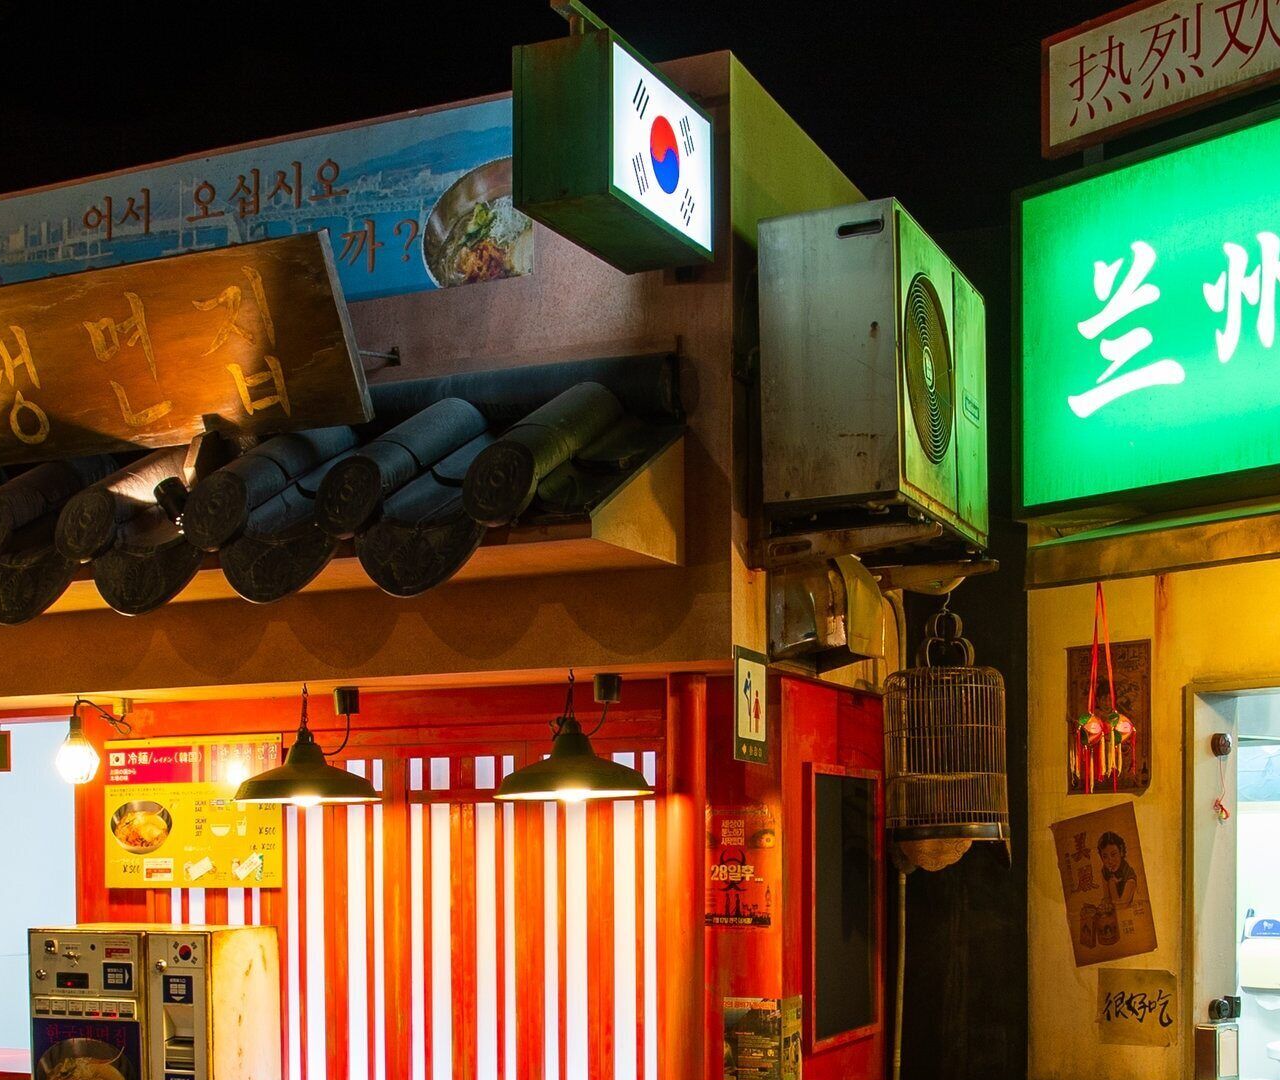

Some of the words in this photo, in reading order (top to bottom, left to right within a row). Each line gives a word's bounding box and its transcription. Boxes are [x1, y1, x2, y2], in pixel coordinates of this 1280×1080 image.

[82, 188, 151, 242] 어서
[186, 158, 350, 225] 오십시오
[1102, 988, 1174, 1028] 很好吃
